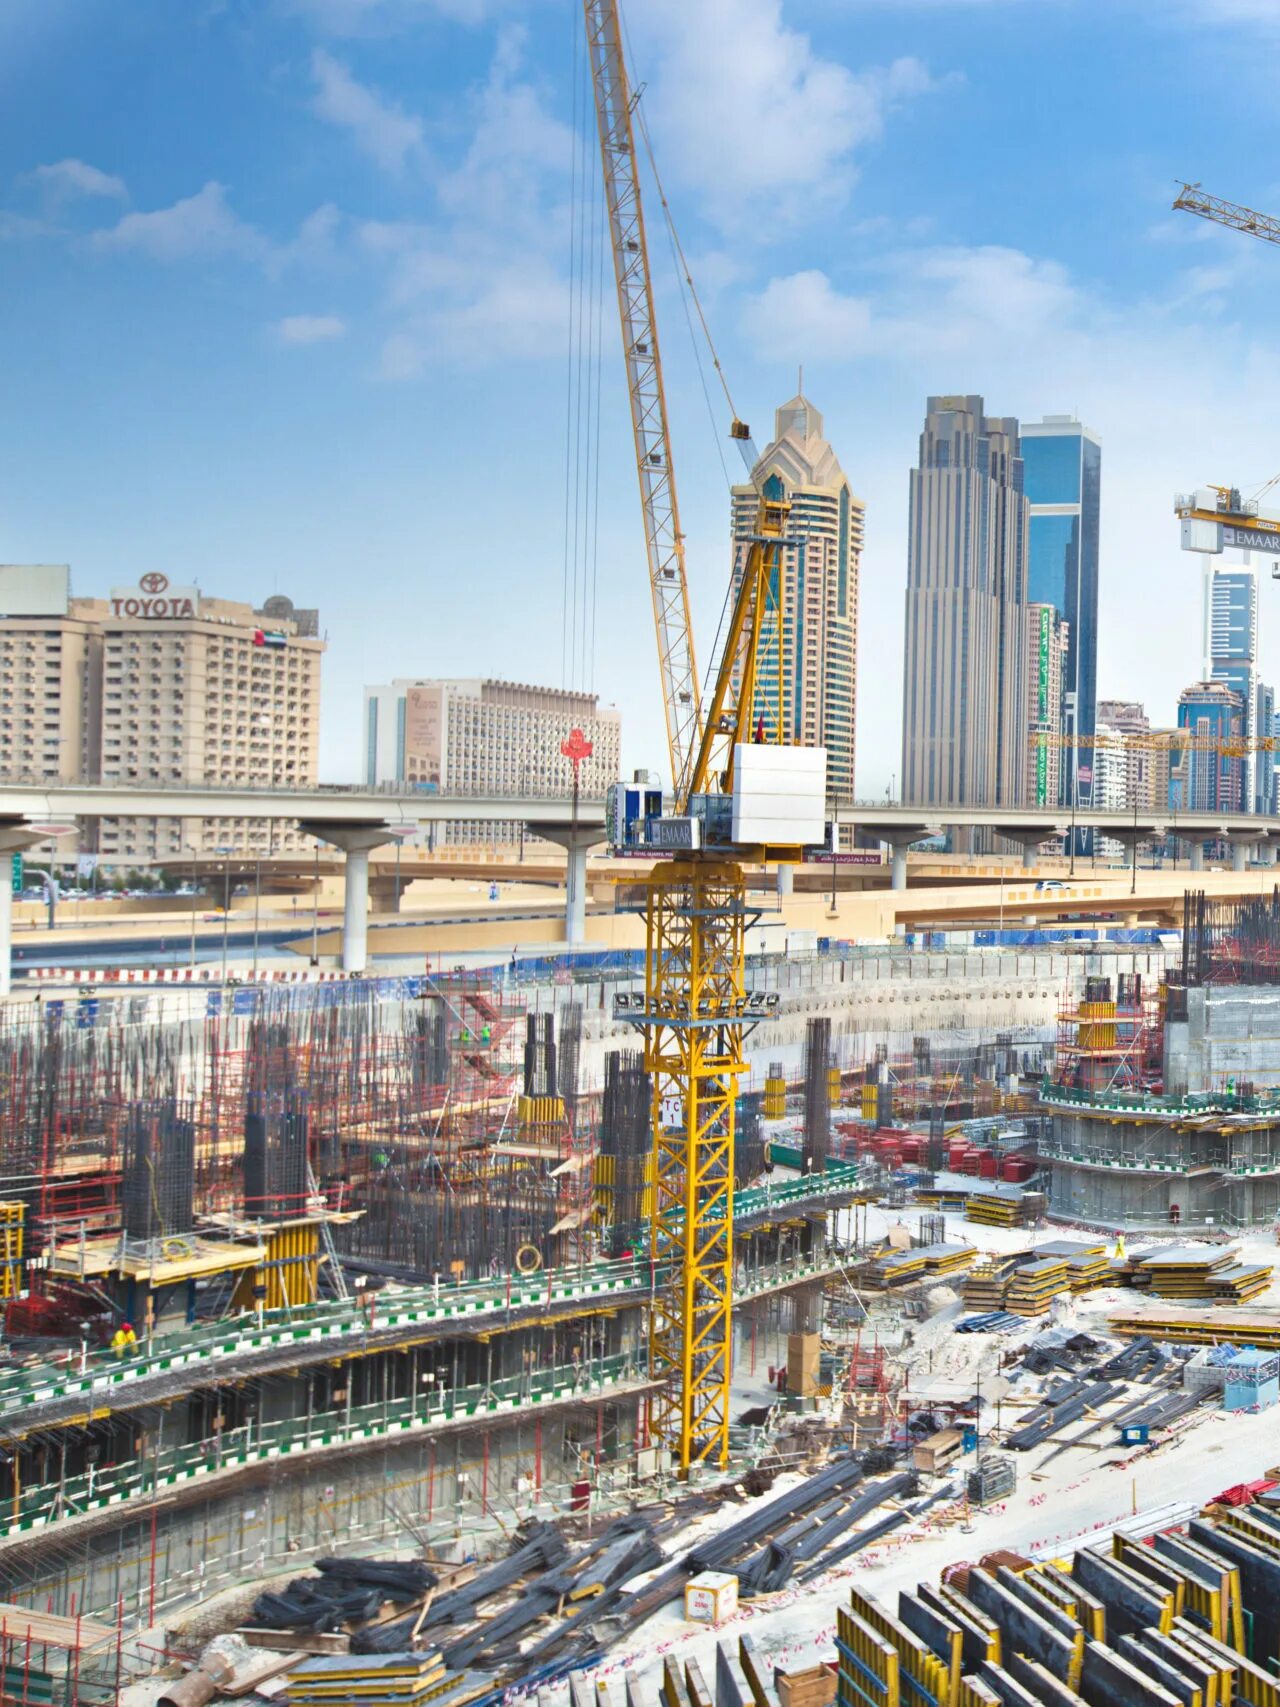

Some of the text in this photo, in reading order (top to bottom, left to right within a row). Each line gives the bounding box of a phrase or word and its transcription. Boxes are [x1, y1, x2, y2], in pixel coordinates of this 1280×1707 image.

[1236, 530, 1280, 550] EMAAR
[111, 598, 195, 618] TOYOTA
[661, 825, 691, 844] EMAAR
[670, 1113, 674, 1124] 1
